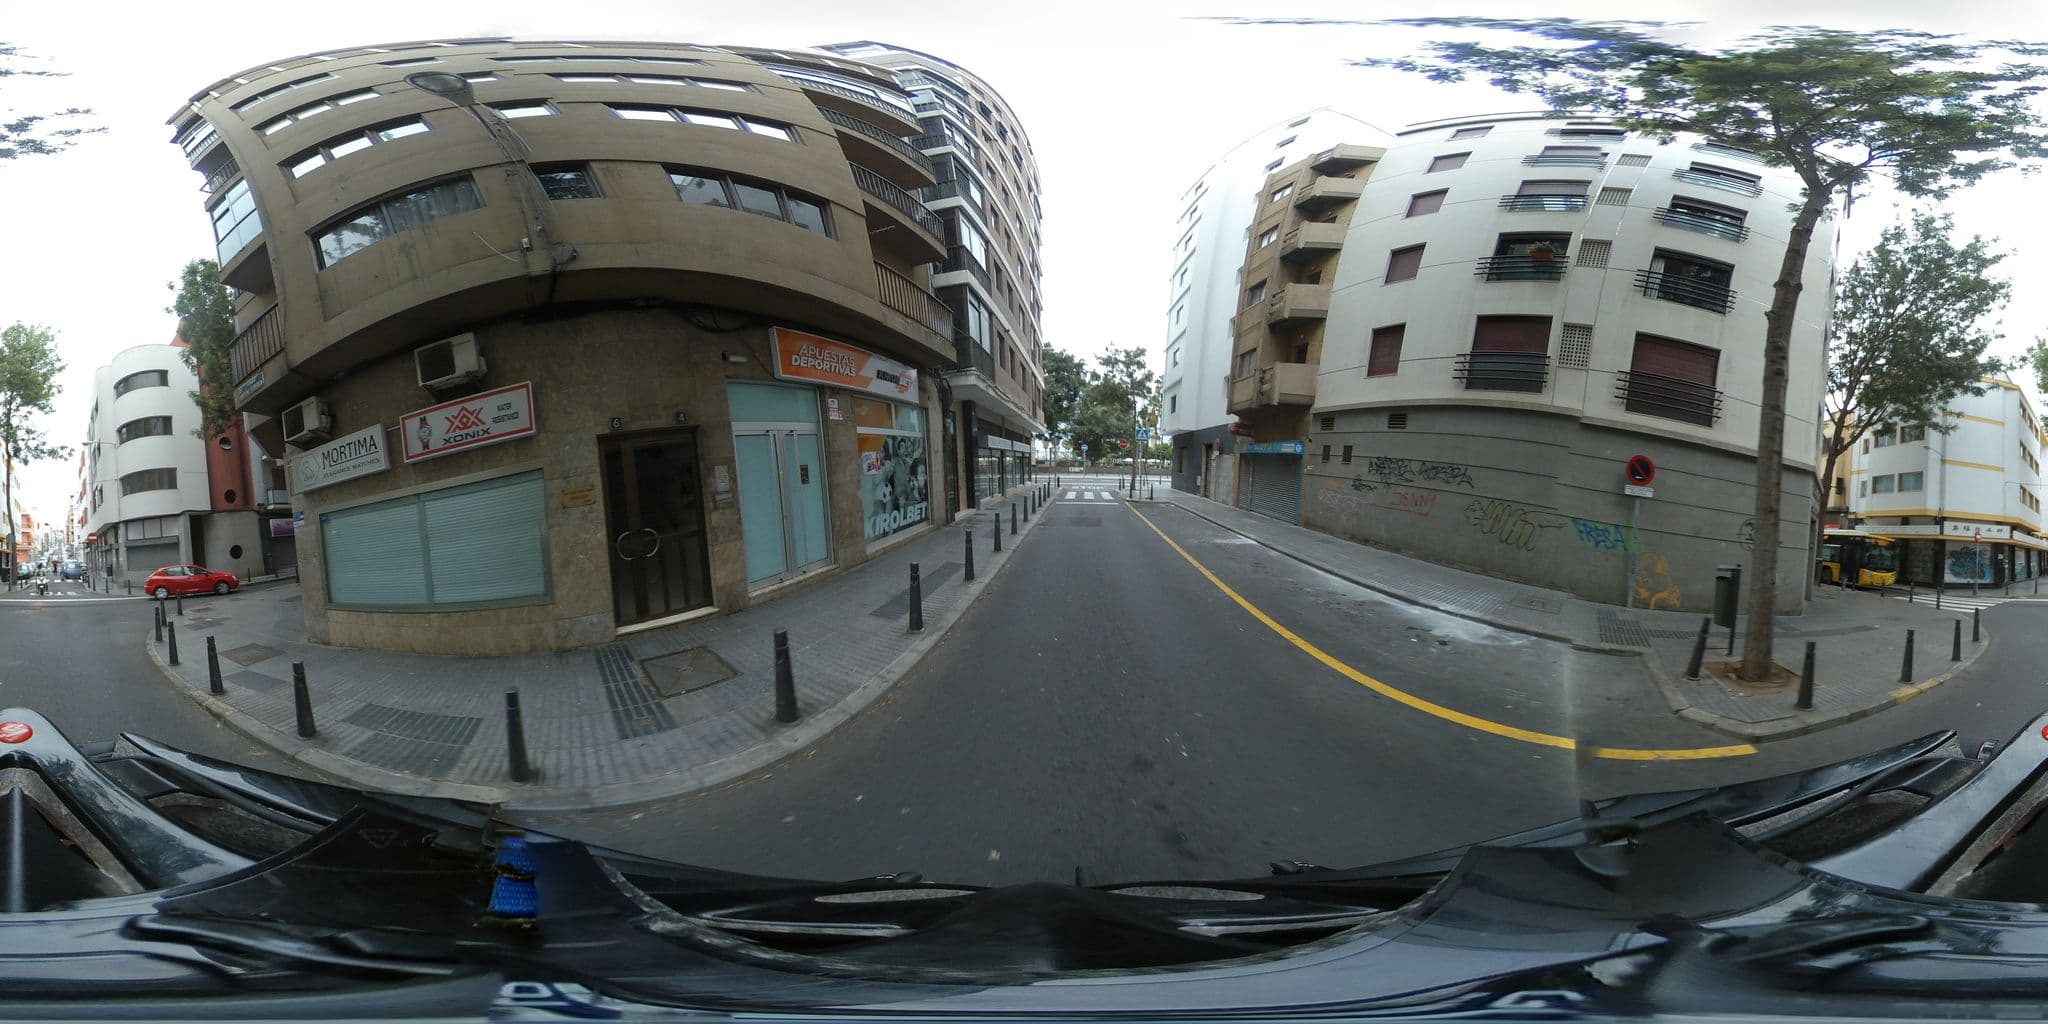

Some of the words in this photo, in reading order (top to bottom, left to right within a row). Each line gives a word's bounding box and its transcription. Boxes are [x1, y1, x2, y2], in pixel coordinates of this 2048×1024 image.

[791, 355, 856, 377] DEPORTIVAS
[799, 345, 855, 366] APUESTAS
[441, 427, 492, 446] XONIX
[321, 434, 379, 470] MORTIMA
[865, 502, 928, 538] KIROLBET
